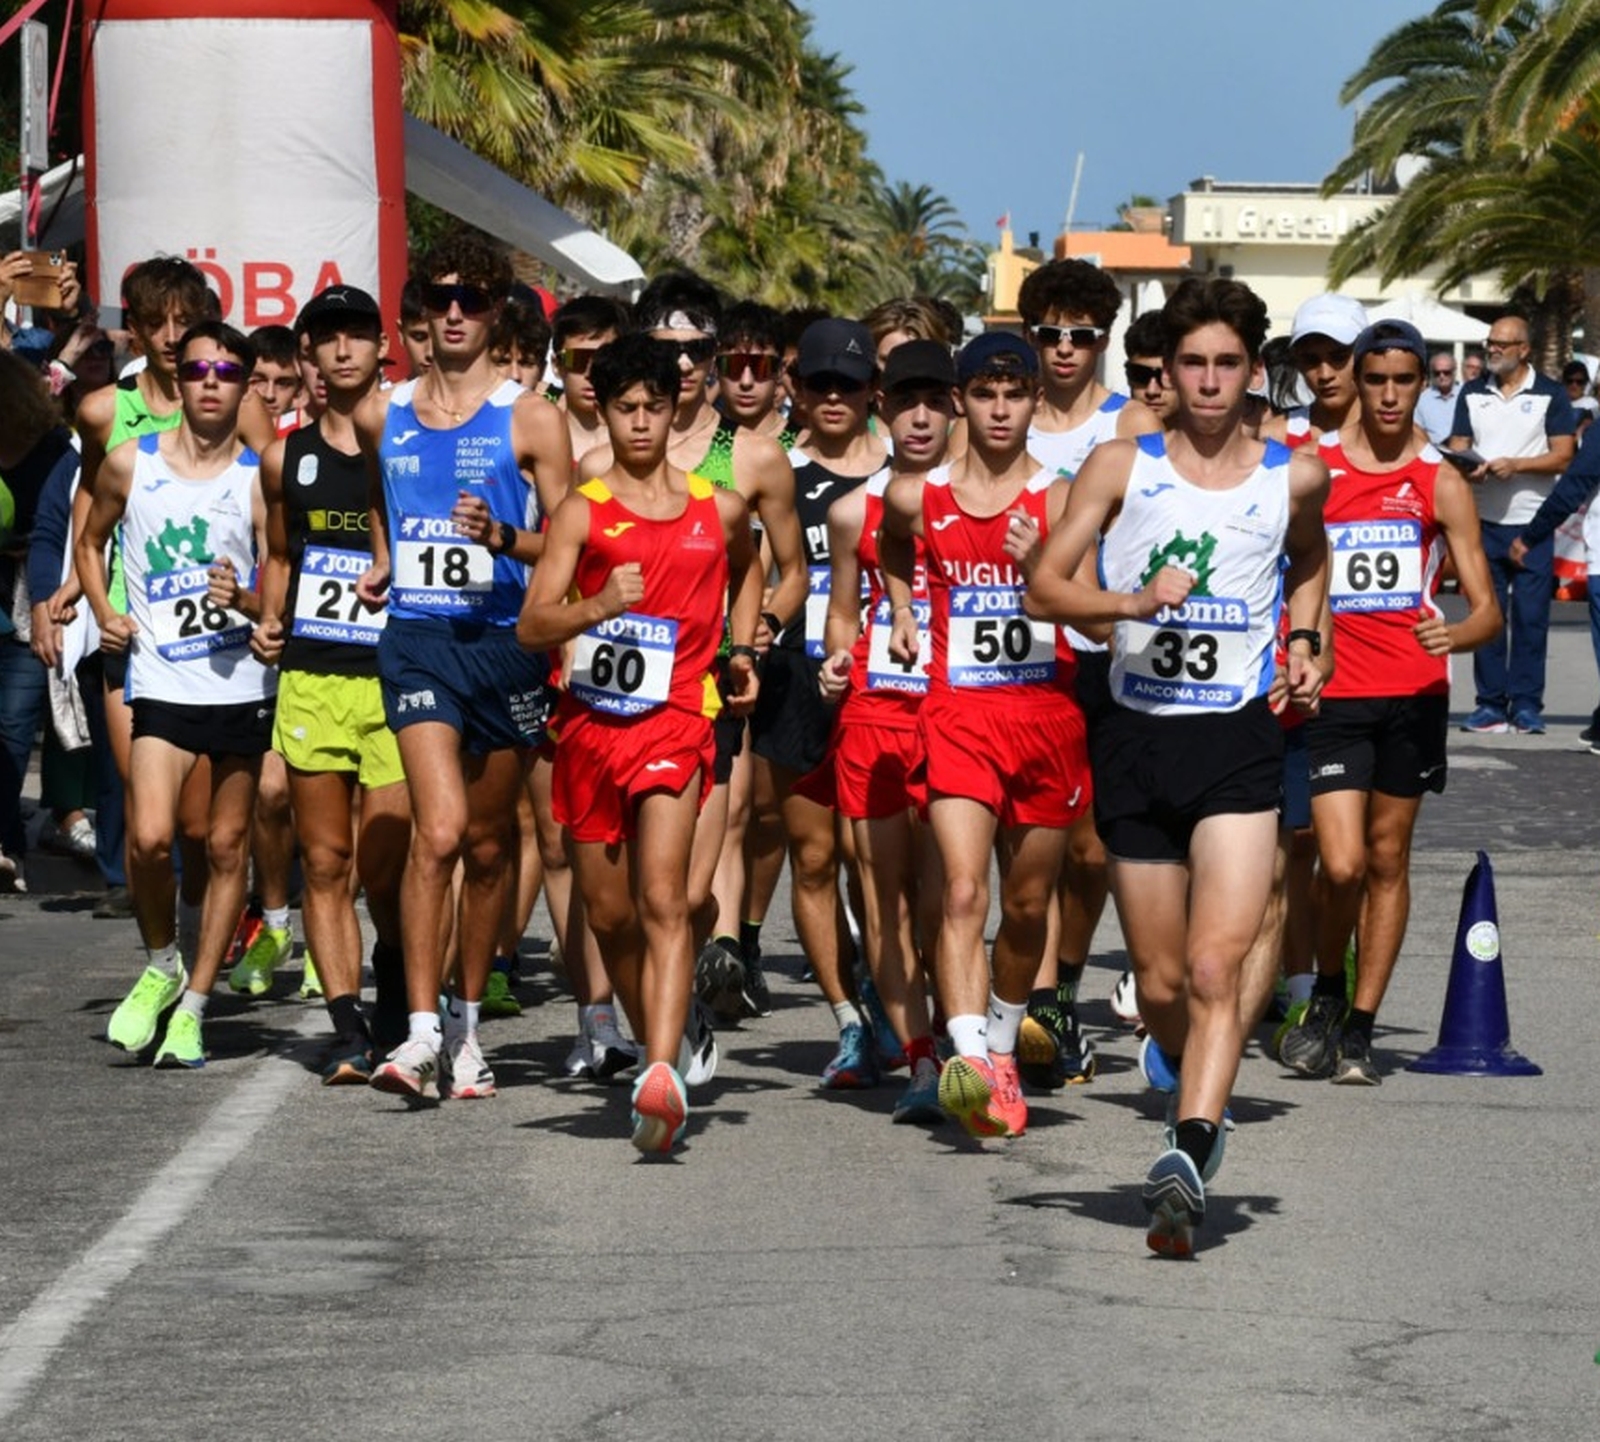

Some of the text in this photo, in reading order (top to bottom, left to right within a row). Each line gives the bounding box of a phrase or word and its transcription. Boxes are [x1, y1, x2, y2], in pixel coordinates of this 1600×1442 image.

[457, 436, 501, 447] IO SONO
[455, 458, 496, 468] VENEZIA
[456, 448, 484, 457] FRIULI
[454, 469, 486, 479] GIULIA
[322, 552, 373, 574] Jom
[418, 545, 470, 588] 18
[1346, 550, 1400, 592] 69
[169, 569, 209, 595] Jom
[315, 579, 363, 623] 27
[399, 593, 484, 606] ANCONA 2025
[972, 590, 1026, 613] Jom
[1336, 596, 1415, 609] ANCONA 2025
[174, 594, 230, 638] 28
[301, 623, 381, 643] ANCONA 2025
[972, 619, 1032, 664] 50
[168, 639, 218, 658] ANCONA
[1151, 630, 1219, 682] 33
[590, 642, 646, 693] 60
[958, 667, 1048, 682] ANCONA 2025
[873, 678, 928, 693] ANCONA
[1133, 681, 1233, 702] ANCONA 2025
